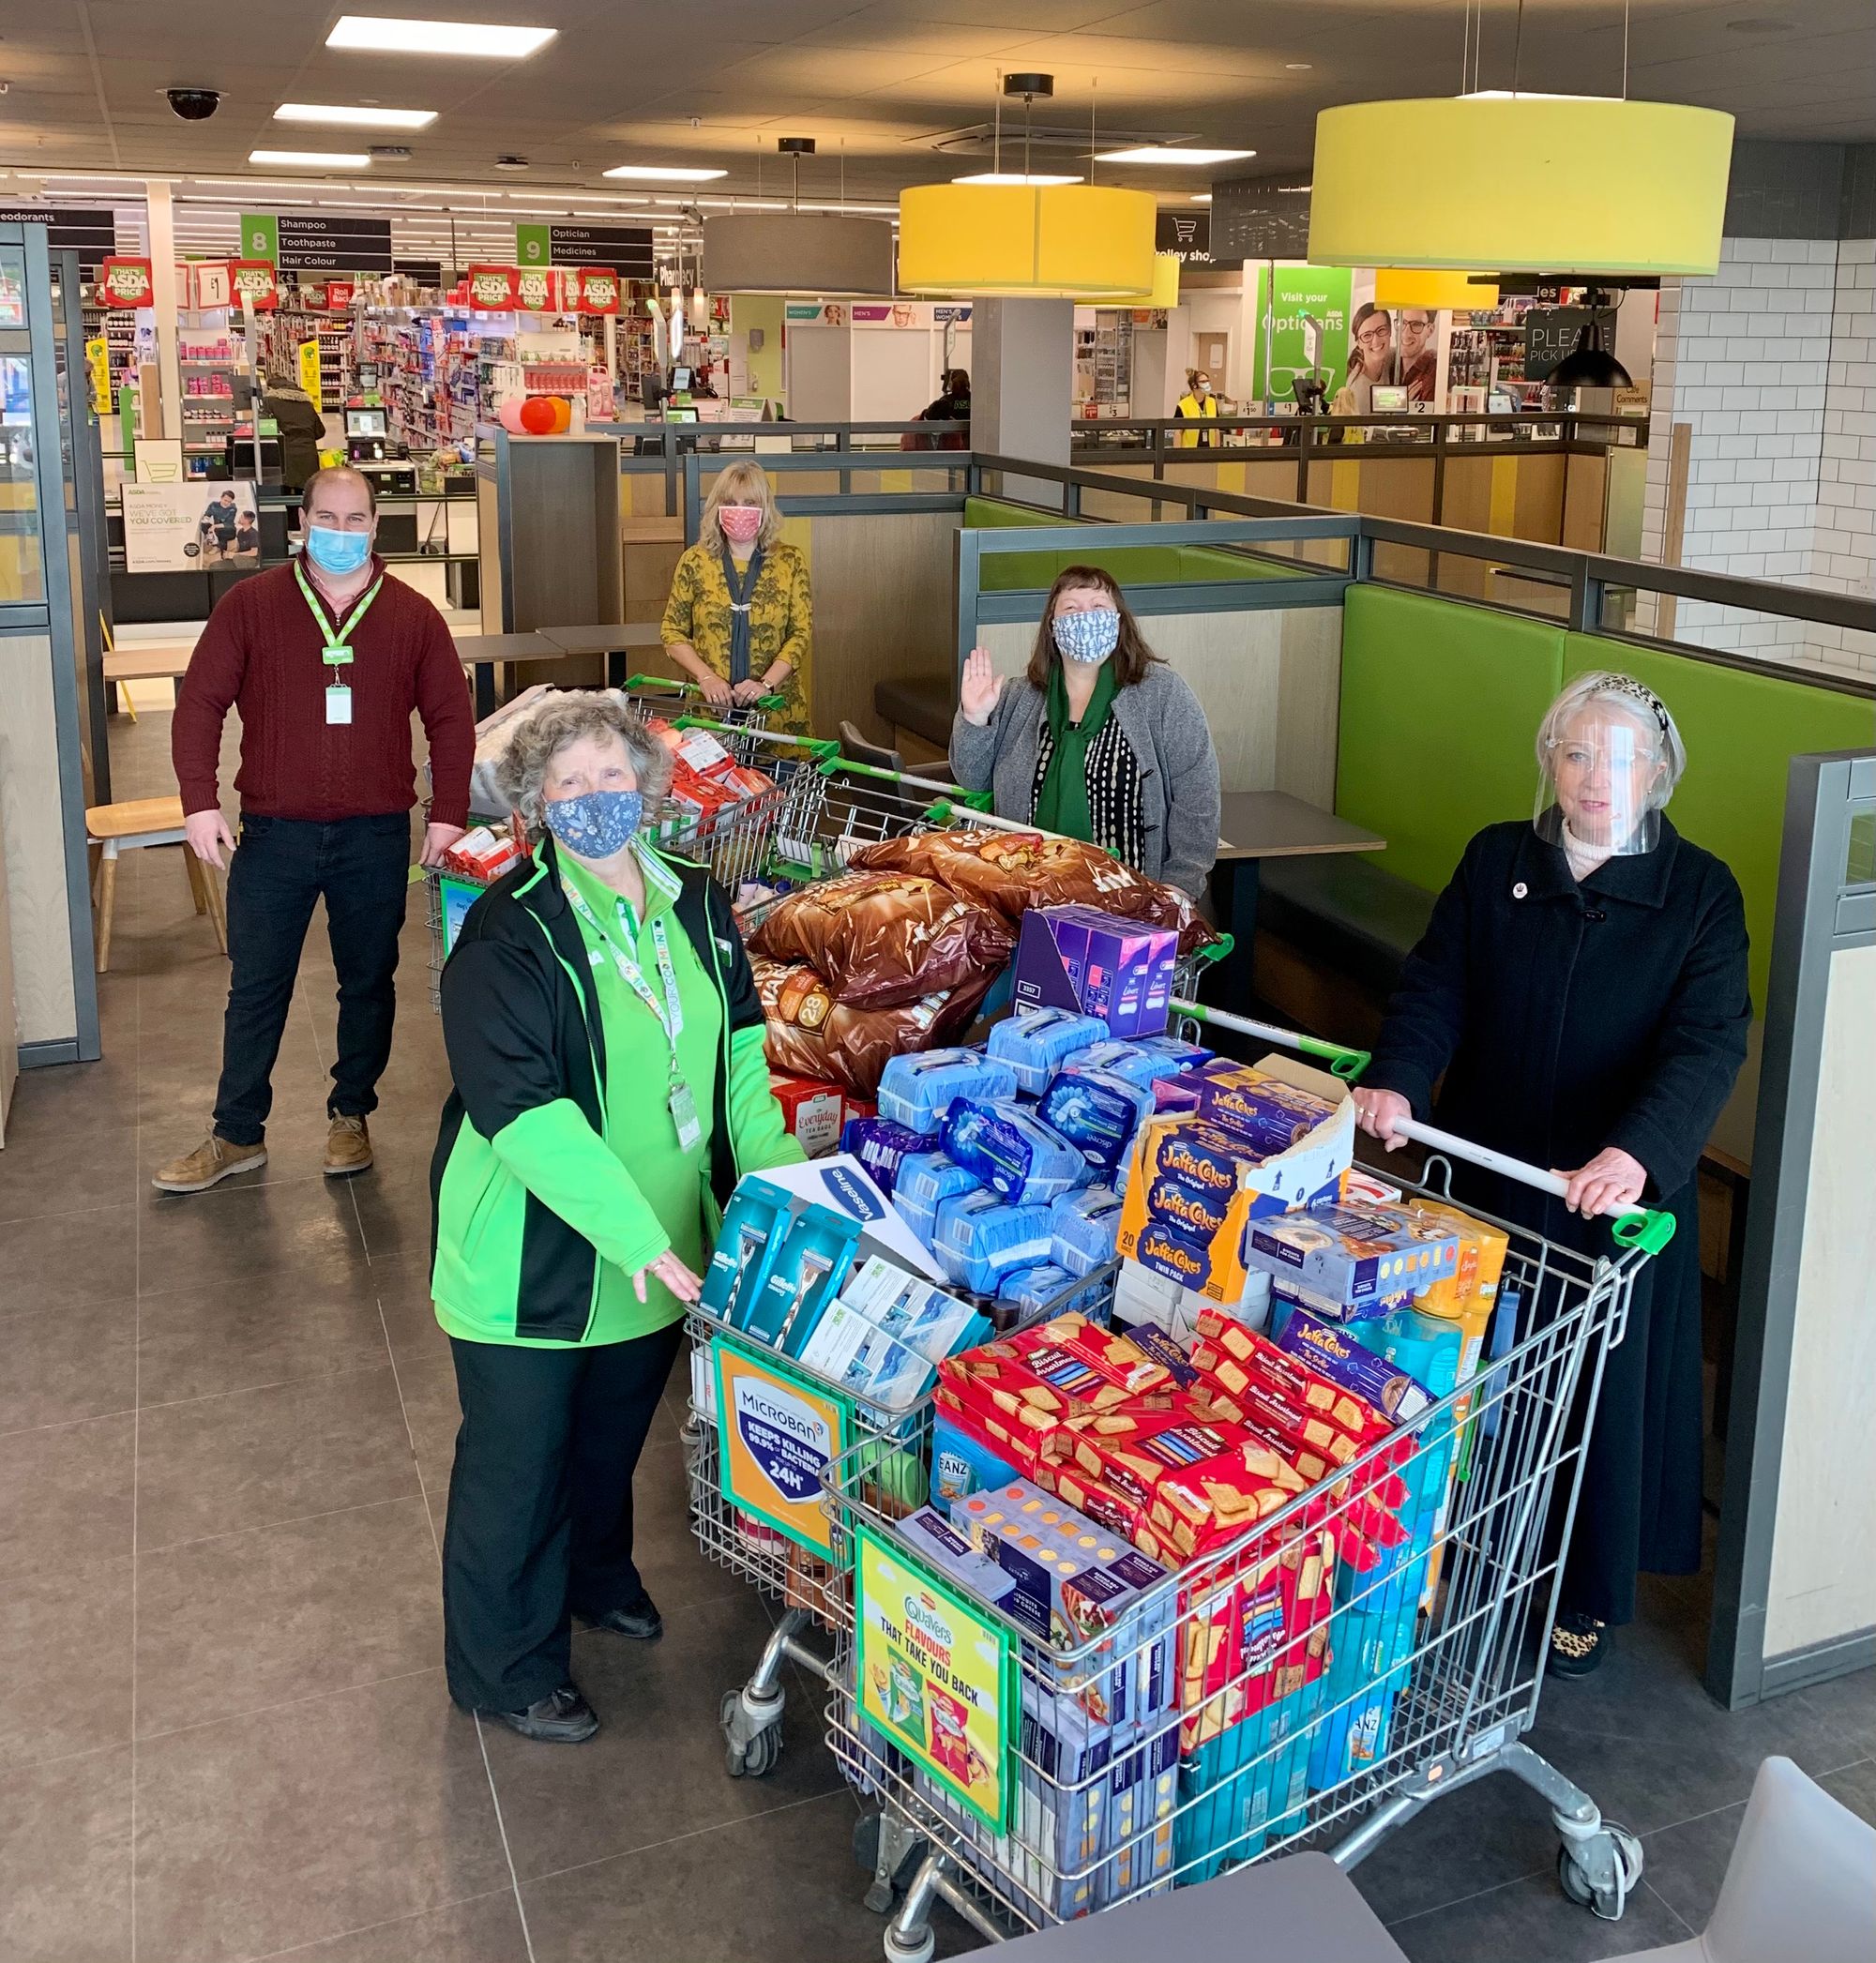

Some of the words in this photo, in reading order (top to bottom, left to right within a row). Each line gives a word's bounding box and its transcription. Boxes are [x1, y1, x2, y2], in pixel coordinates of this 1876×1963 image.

[0, 212, 54, 221] eodorants
[280, 219, 326, 231] Shampoo
[251, 232, 267, 251] 8
[552, 229, 590, 239] Optician
[281, 237, 336, 249] Toothpaste
[526, 240, 541, 260] 9
[553, 246, 597, 257] Medicines
[281, 255, 301, 265] Hair
[304, 256, 336, 265] Colour
[1155, 249, 1188, 263] rolley
[1189, 249, 1216, 263] sho
[107, 274, 150, 289] ASDA
[234, 276, 275, 290] ASDA
[471, 280, 511, 295] ASDA
[518, 279, 549, 296] ASDA
[114, 288, 143, 296] PRICE
[478, 294, 504, 302] PRICE
[582, 284, 616, 297] ASDA
[1281, 292, 1303, 302] Visit
[1306, 293, 1327, 304] your
[523, 294, 544, 305] PRICE
[1262, 314, 1343, 333] Opticans
[1532, 327, 1610, 347] PLEAE
[1530, 350, 1559, 361] PICK
[1415, 401, 1425, 414] £2
[1616, 394, 1648, 404] Comments
[1284, 403, 1293, 413] £1
[801, 995, 822, 1022] 28
[1211, 1092, 1235, 1111] Jaffa
[1234, 1099, 1258, 1117] Cakes
[798, 1110, 839, 1129] Everyday
[1086, 1133, 1112, 1149] discreet
[1162, 1145, 1197, 1173] Jaffa
[1196, 1159, 1232, 1188] Cakes
[1185, 1176, 1204, 1190] Original
[832, 1168, 873, 1221] Vaseline
[1154, 1186, 1188, 1216] Jaffa
[1187, 1201, 1223, 1231] Cakes
[1176, 1218, 1196, 1232] Original
[1123, 1231, 1134, 1247] 20
[715, 1251, 738, 1269] Gillette
[1144, 1237, 1174, 1261] Jaffa
[1172, 1249, 1202, 1274] Cakes
[1155, 1261, 1169, 1276] TWIN
[1169, 1267, 1184, 1282] PACK
[770, 1276, 797, 1293] Gillette
[1146, 1333, 1171, 1351] Jaffa
[1297, 1323, 1324, 1347] Jaffa
[1324, 1336, 1351, 1359] Cakes
[1032, 1351, 1064, 1368] Biscuit
[1036, 1355, 1078, 1376] Assortment
[1255, 1351, 1275, 1367] Biscuit
[1274, 1365, 1306, 1388] Assortment
[1248, 1385, 1270, 1402] Biscuit
[1269, 1397, 1302, 1422] Assortment
[742, 1390, 816, 1442] MICROBAN
[748, 1421, 780, 1445] KEEPS
[781, 1438, 821, 1468] KILLING
[749, 1432, 774, 1452] 99.9%
[1169, 1427, 1218, 1457] Assortment
[1185, 1427, 1221, 1451] Biscuit
[1244, 1420, 1264, 1433] Biscuit
[1263, 1433, 1295, 1456] Assortment
[939, 1457, 967, 1474] EANZ
[1105, 1466, 1122, 1482] Biscuit
[1014, 1592, 1037, 1609] ISCUITS
[1021, 1601, 1041, 1618] CHEESE
[904, 1596, 952, 1645] Quavers
[904, 1619, 951, 1667] FLAVOURS
[881, 1616, 902, 1645] THAT
[905, 1638, 927, 1669] TAKE
[930, 1659, 949, 1684] YOU
[952, 1674, 978, 1707] BACK
